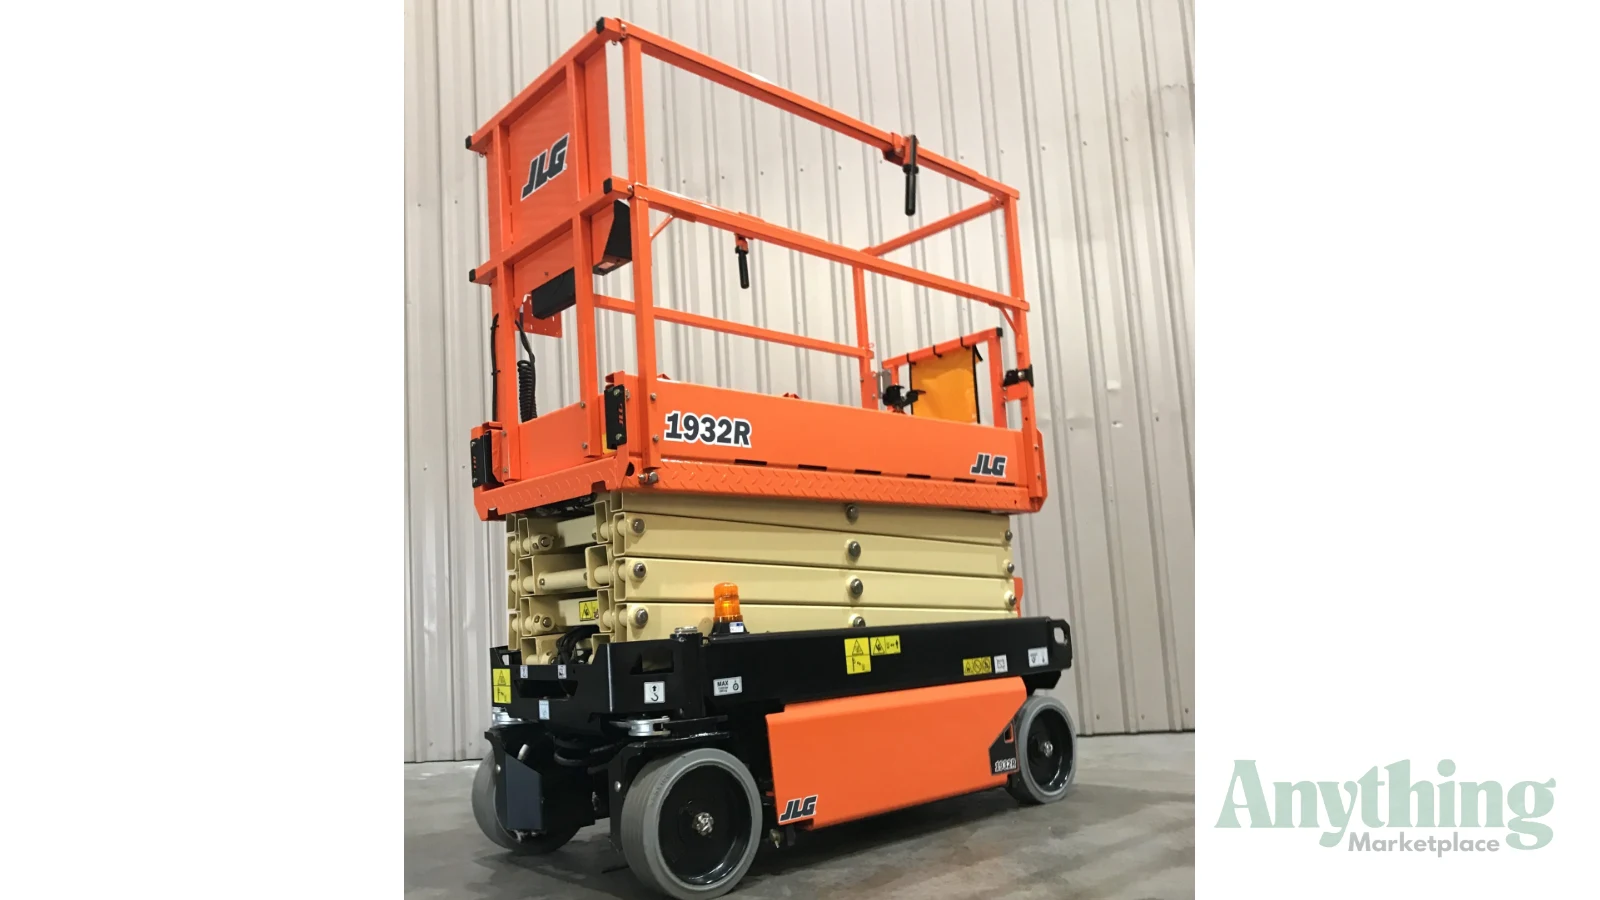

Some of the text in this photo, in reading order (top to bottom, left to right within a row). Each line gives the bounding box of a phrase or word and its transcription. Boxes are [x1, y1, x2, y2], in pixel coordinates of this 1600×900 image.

[521, 133, 569, 201] JLG
[665, 411, 752, 448] 1932R
[970, 452, 1007, 477] JLG
[995, 758, 1017, 772] 1932R
[779, 795, 818, 823] JLG
